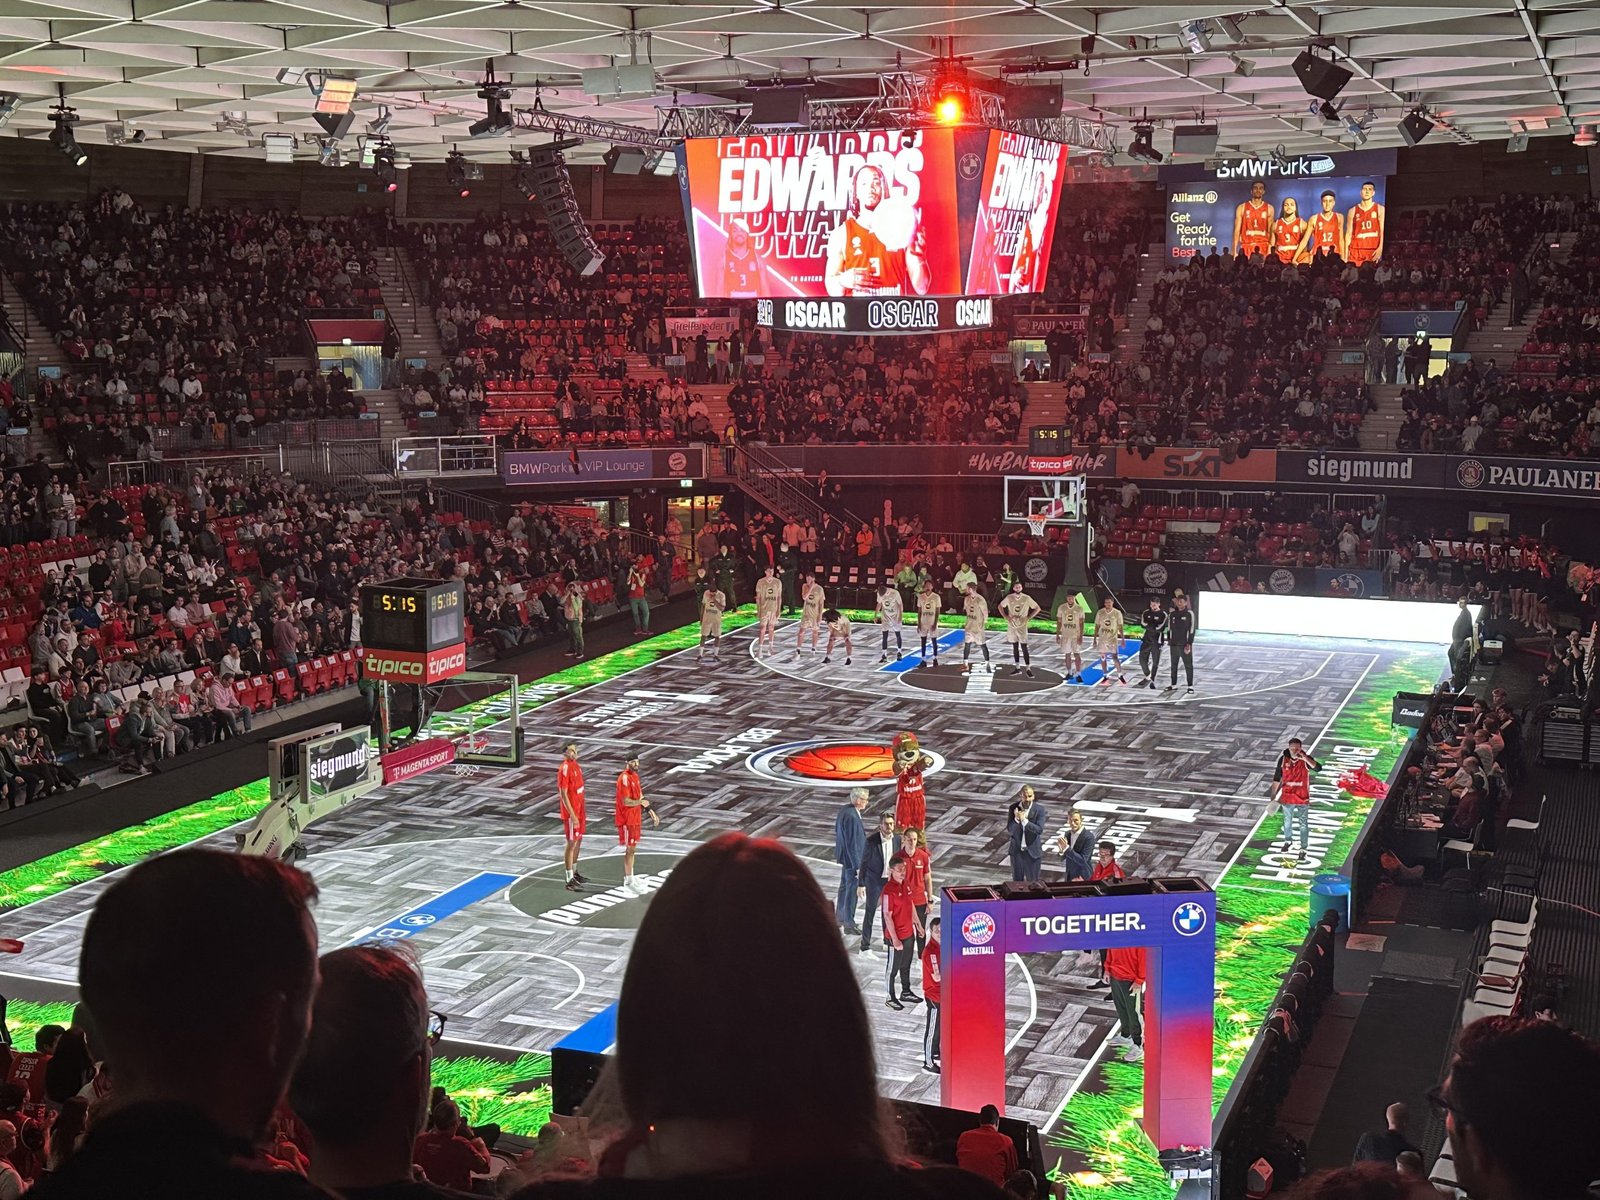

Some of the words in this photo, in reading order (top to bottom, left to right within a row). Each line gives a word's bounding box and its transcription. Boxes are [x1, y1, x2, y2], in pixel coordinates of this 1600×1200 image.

[1171, 192, 1204, 203] Allianz
[1170, 211, 1190, 223] Get
[1176, 223, 1212, 236] Ready
[1361, 220, 1372, 230] 10
[1180, 234, 1196, 246] for
[1198, 234, 1217, 246] the
[1322, 232, 1333, 242] 12
[1172, 247, 1197, 258] Best
[785, 301, 846, 328] OSCAR
[868, 300, 938, 328] OSCAR
[509, 462, 567, 475] BMWPark
[584, 460, 603, 472] VIP
[606, 460, 645, 473] Lounge
[1030, 460, 1061, 469] tipico
[1307, 455, 1413, 482] siegmund
[382, 594, 417, 613] 5:15
[365, 653, 424, 676] tipico
[428, 653, 464, 676] tipico
[726, 727, 782, 743] BBL
[310, 742, 366, 779] siegmund
[429, 751, 449, 766] SPORT
[666, 744, 751, 774] POKAL
[1020, 912, 1146, 936] TOGETHER.
[962, 946, 995, 955] BASKETBALL
